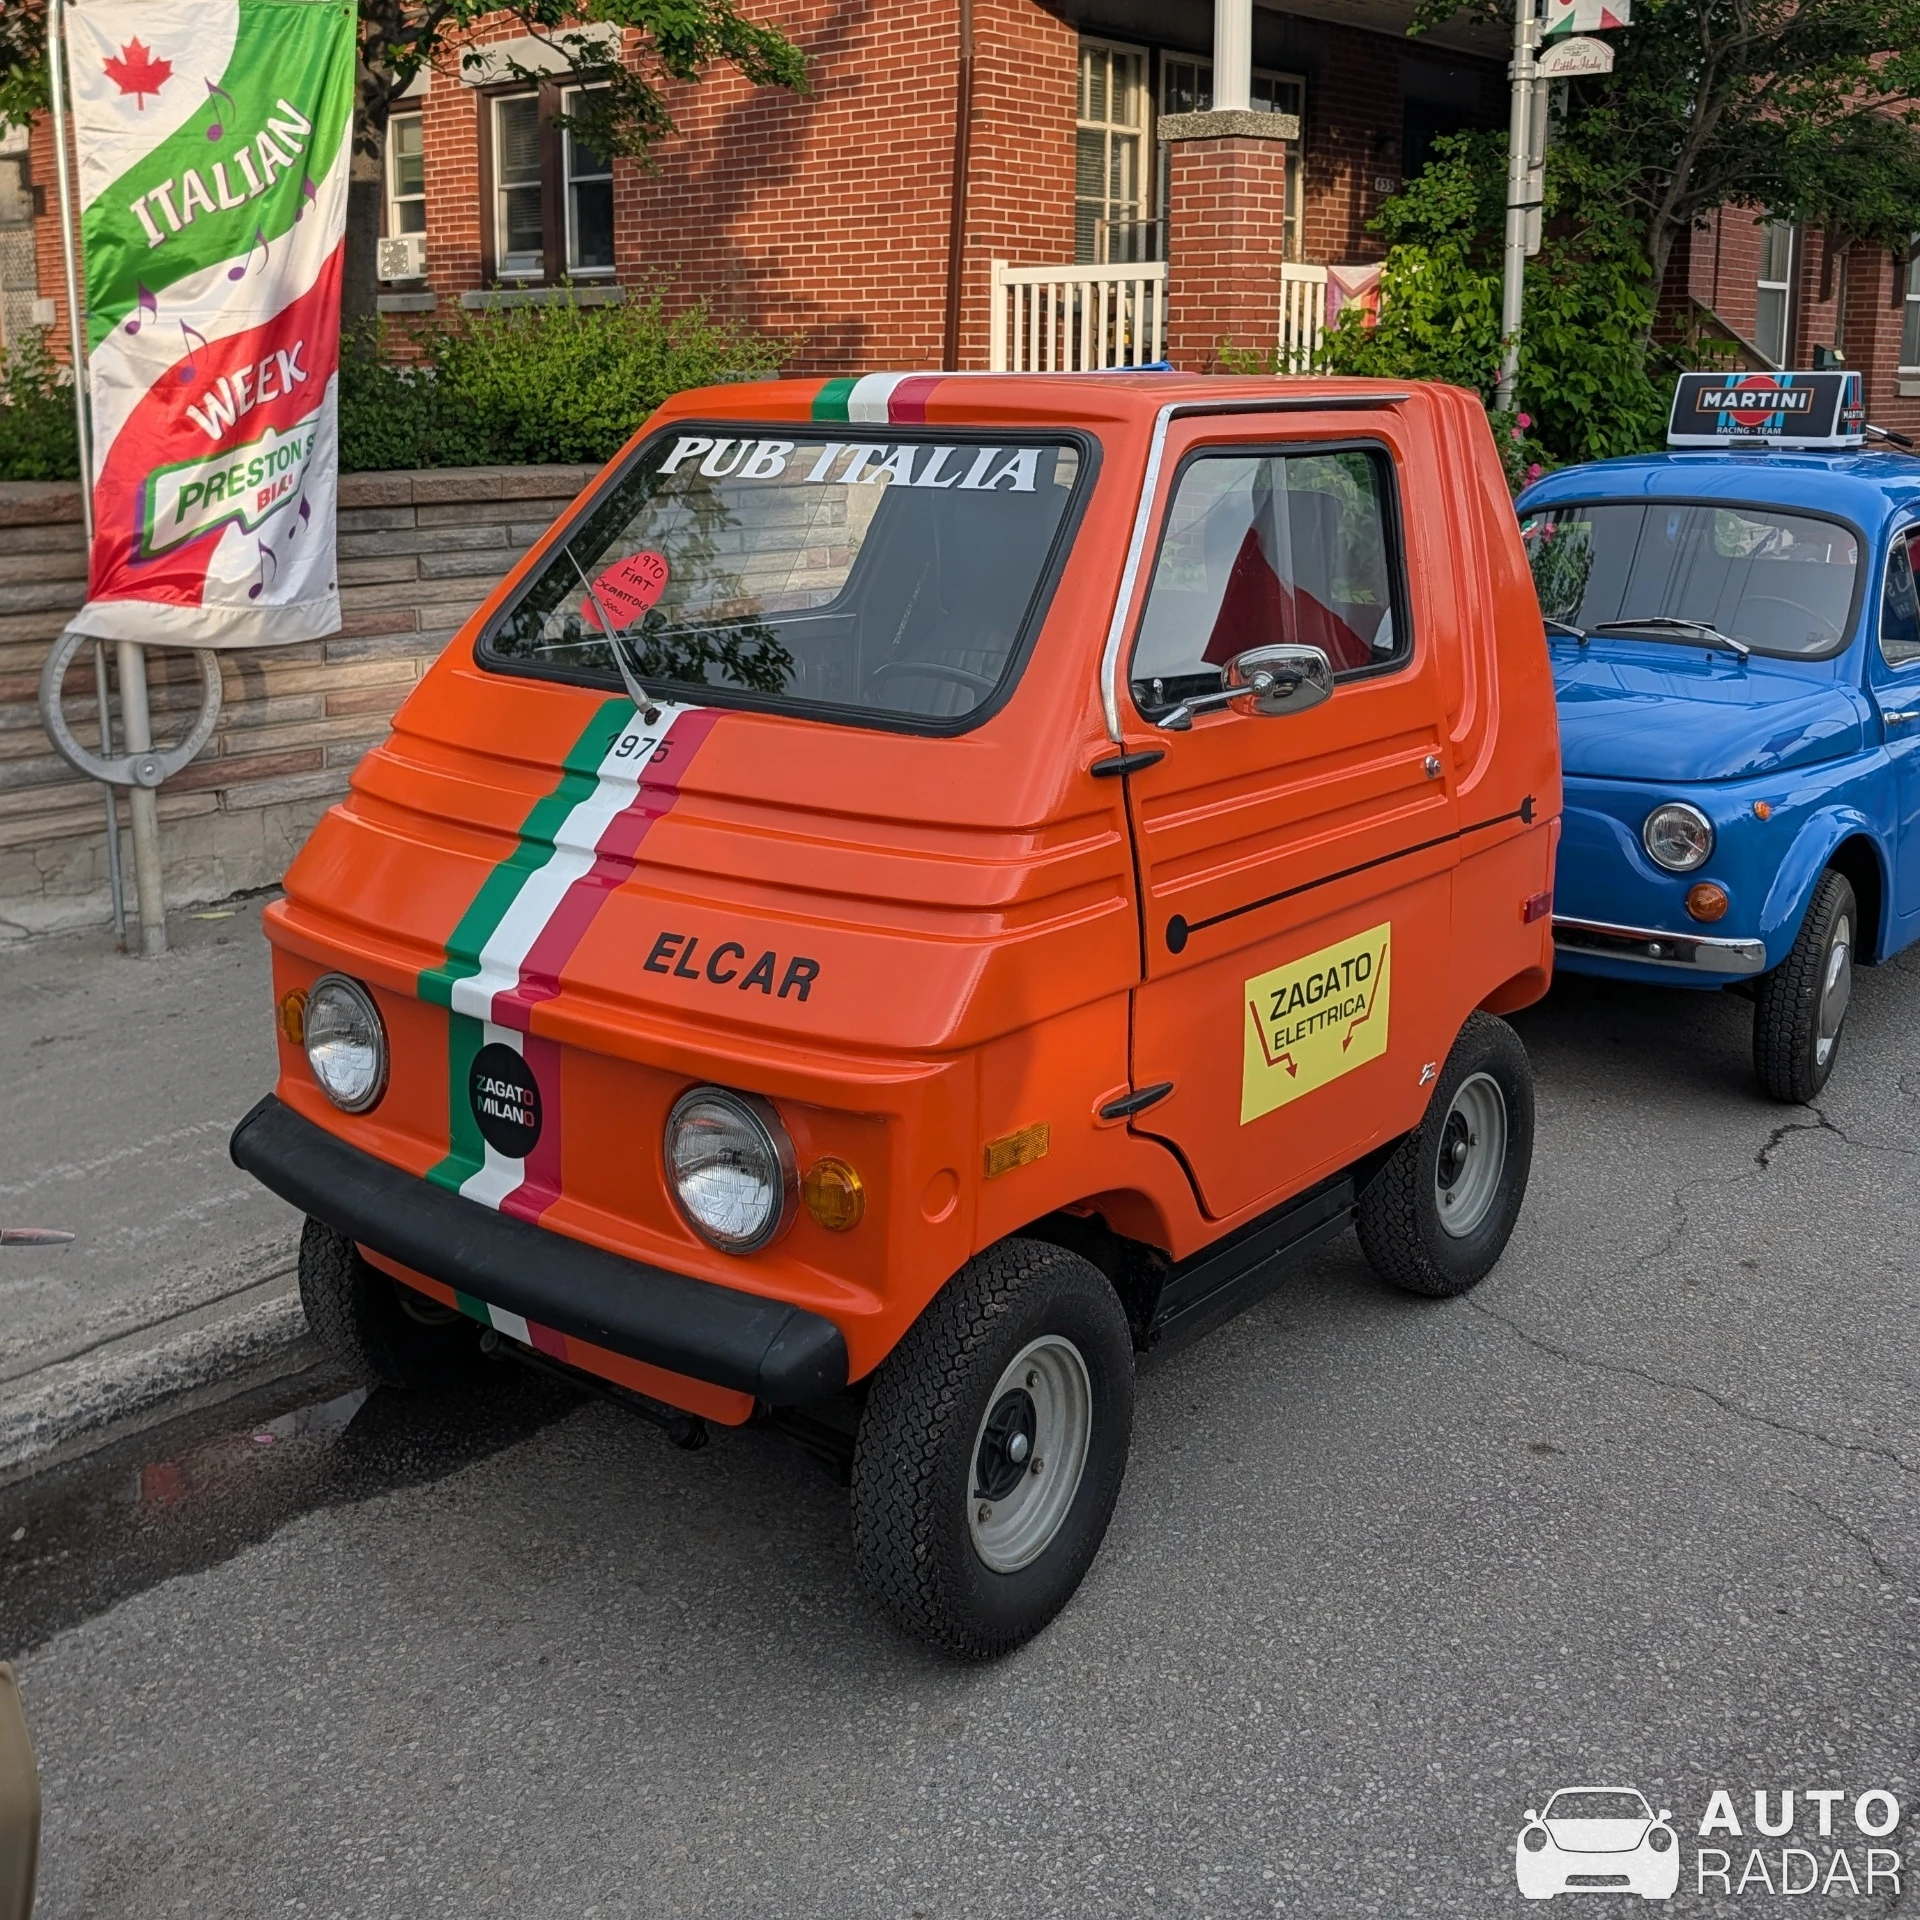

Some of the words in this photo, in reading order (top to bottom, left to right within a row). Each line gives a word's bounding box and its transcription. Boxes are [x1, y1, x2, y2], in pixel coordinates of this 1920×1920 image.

[1549, 57, 1577, 72] Little
[1578, 56, 1601, 71] Italy
[130, 99, 312, 248] ITALIAN
[186, 340, 307, 440] WEEK
[1703, 392, 1806, 408] MARTINI
[1716, 427, 1750, 435] RACING
[1757, 427, 1782, 435] TEAM
[174, 439, 302, 525] PRESTON
[306, 431, 316, 455] S
[656, 437, 795, 479] PUB
[804, 443, 1043, 491] ITALIA
[620, 566, 655, 591] FIAT
[633, 555, 664, 579] 1970
[603, 732, 675, 764] 1975
[643, 932, 820, 1002] ELCAR
[1269, 952, 1371, 1022] ZAGATO
[1274, 993, 1366, 1051] ELETTRICA
[476, 1074, 534, 1106] ZAGATO
[477, 1095, 535, 1128] MILANO
